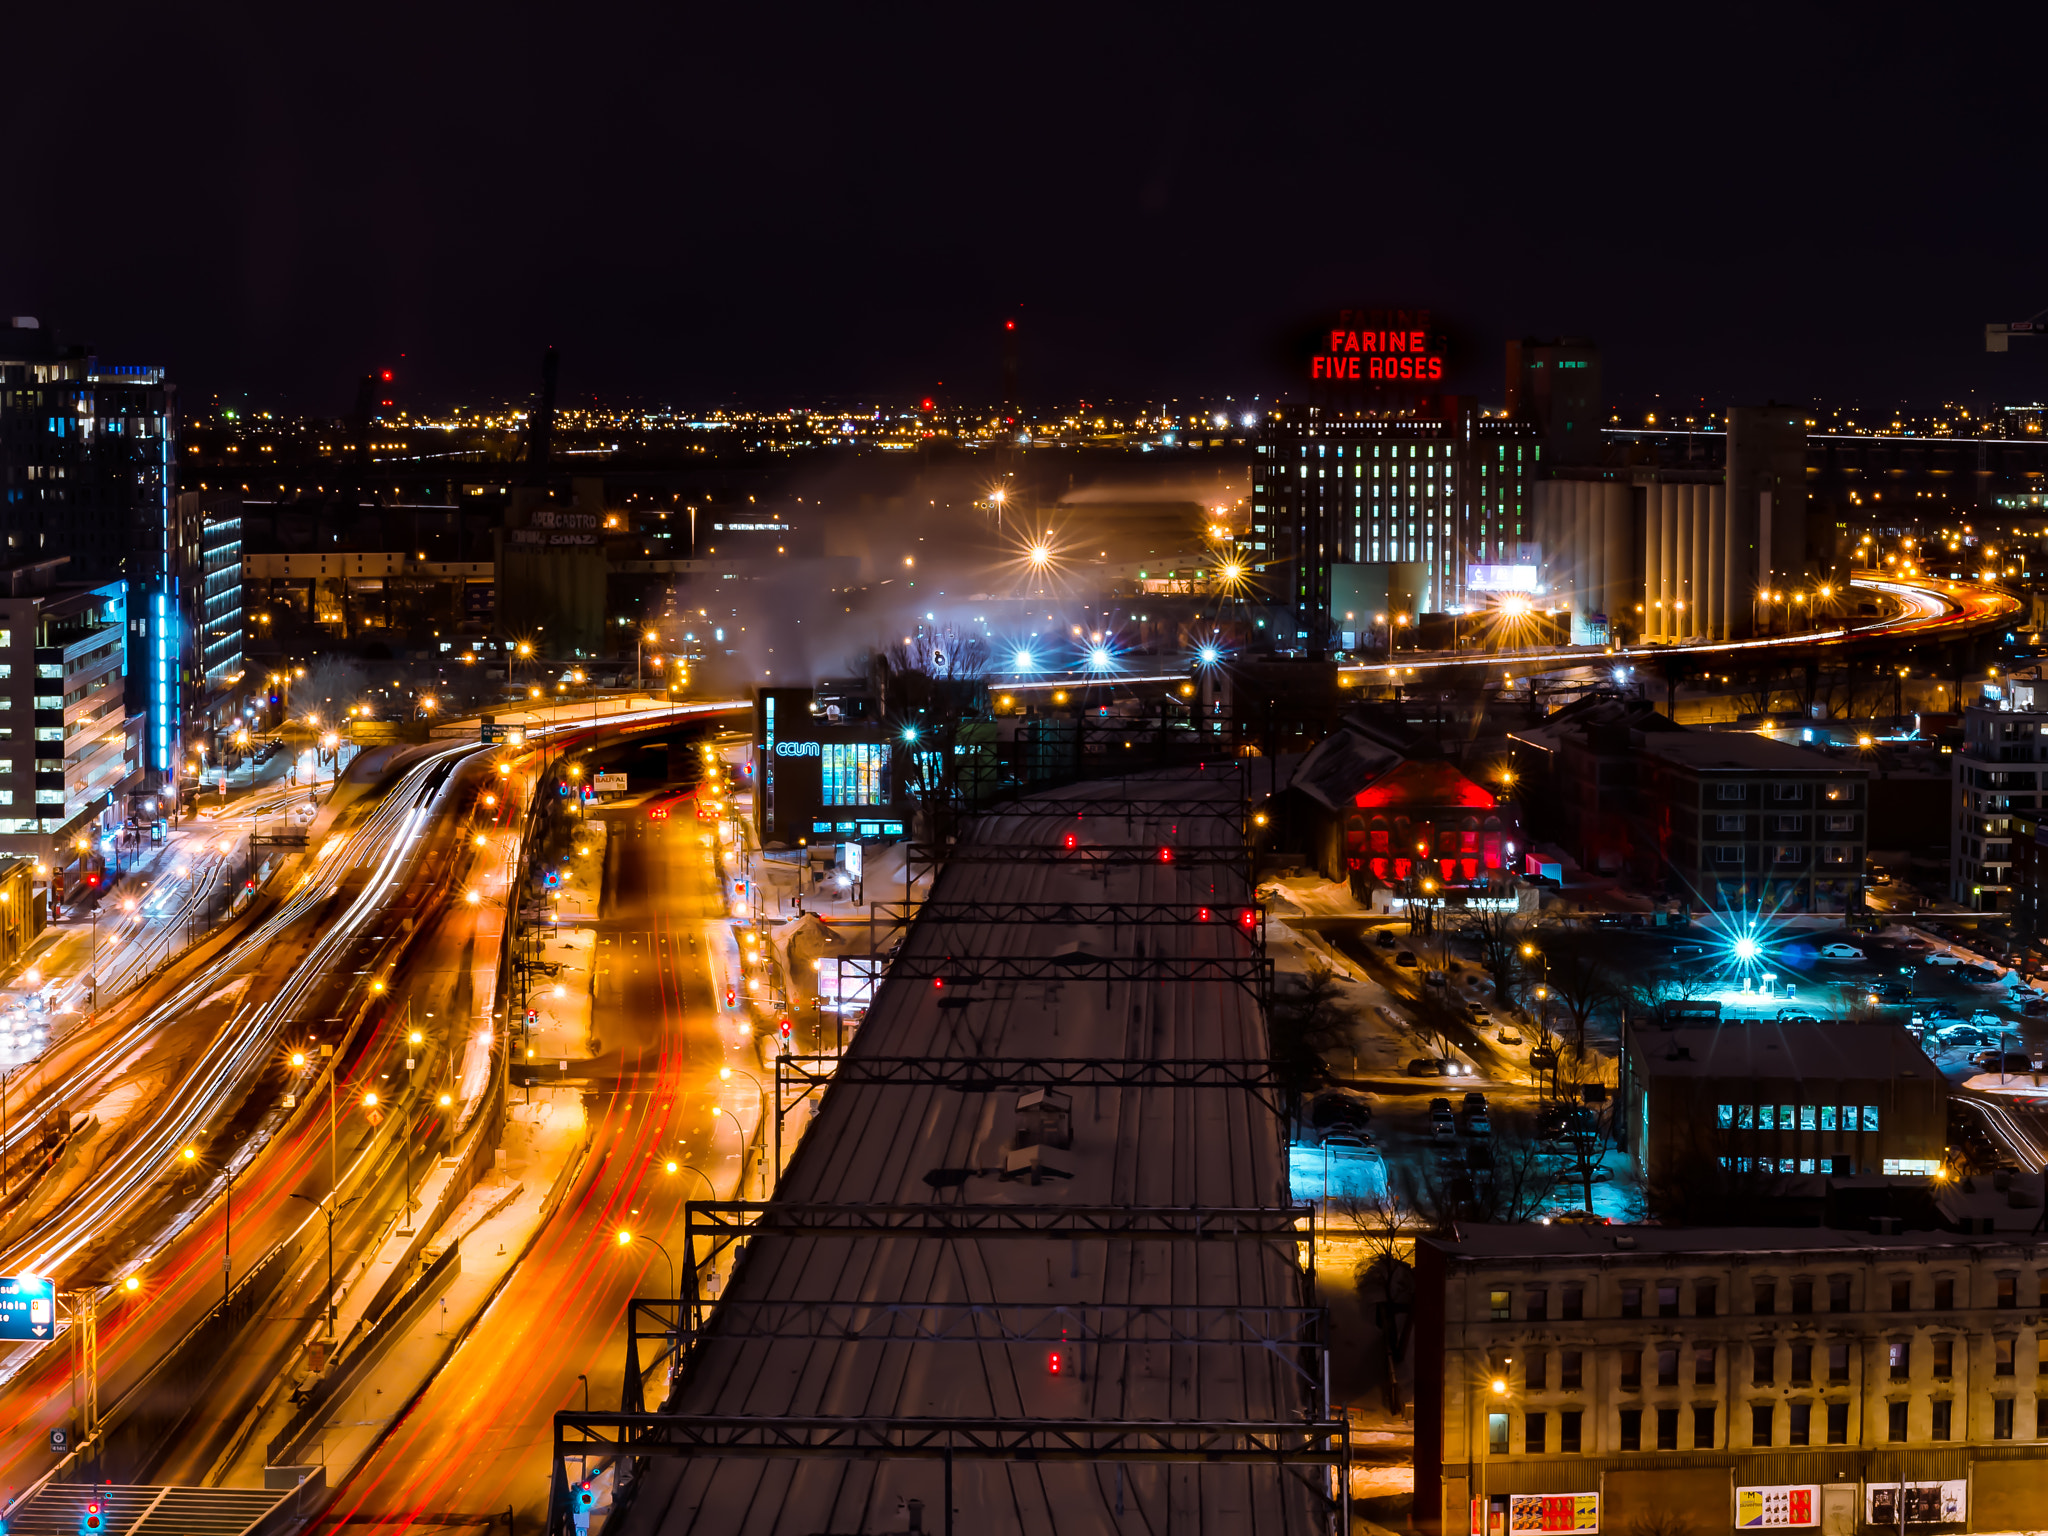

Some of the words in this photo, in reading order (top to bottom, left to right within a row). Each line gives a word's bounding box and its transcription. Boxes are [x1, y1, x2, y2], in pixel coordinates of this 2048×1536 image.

[1331, 331, 1425, 352] FARINE
[1311, 356, 1361, 379] FIVE
[1369, 356, 1442, 379] ROSES
[0, 1300, 27, 1311] lain
